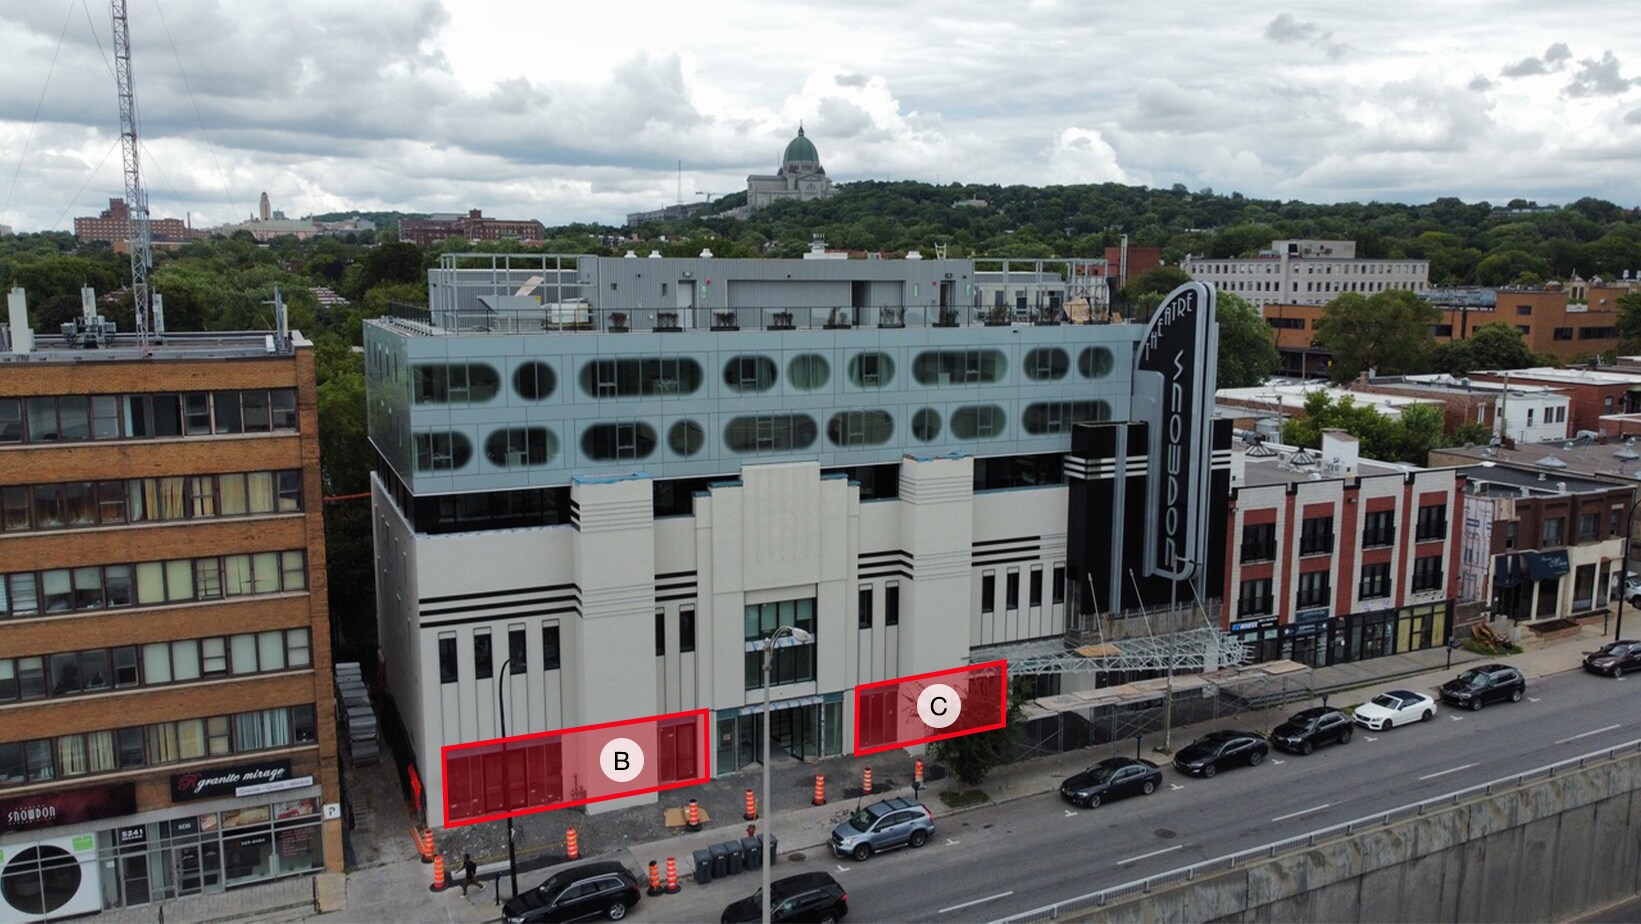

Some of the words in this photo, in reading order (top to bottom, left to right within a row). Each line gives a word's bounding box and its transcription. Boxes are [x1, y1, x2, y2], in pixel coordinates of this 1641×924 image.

[1145, 292, 1193, 361] THEATRE
[1164, 349, 1184, 568] SNOWDON
[242, 767, 286, 782] mirage
[7, 805, 56, 823] SNOWDON
[121, 828, 143, 838] 5241
